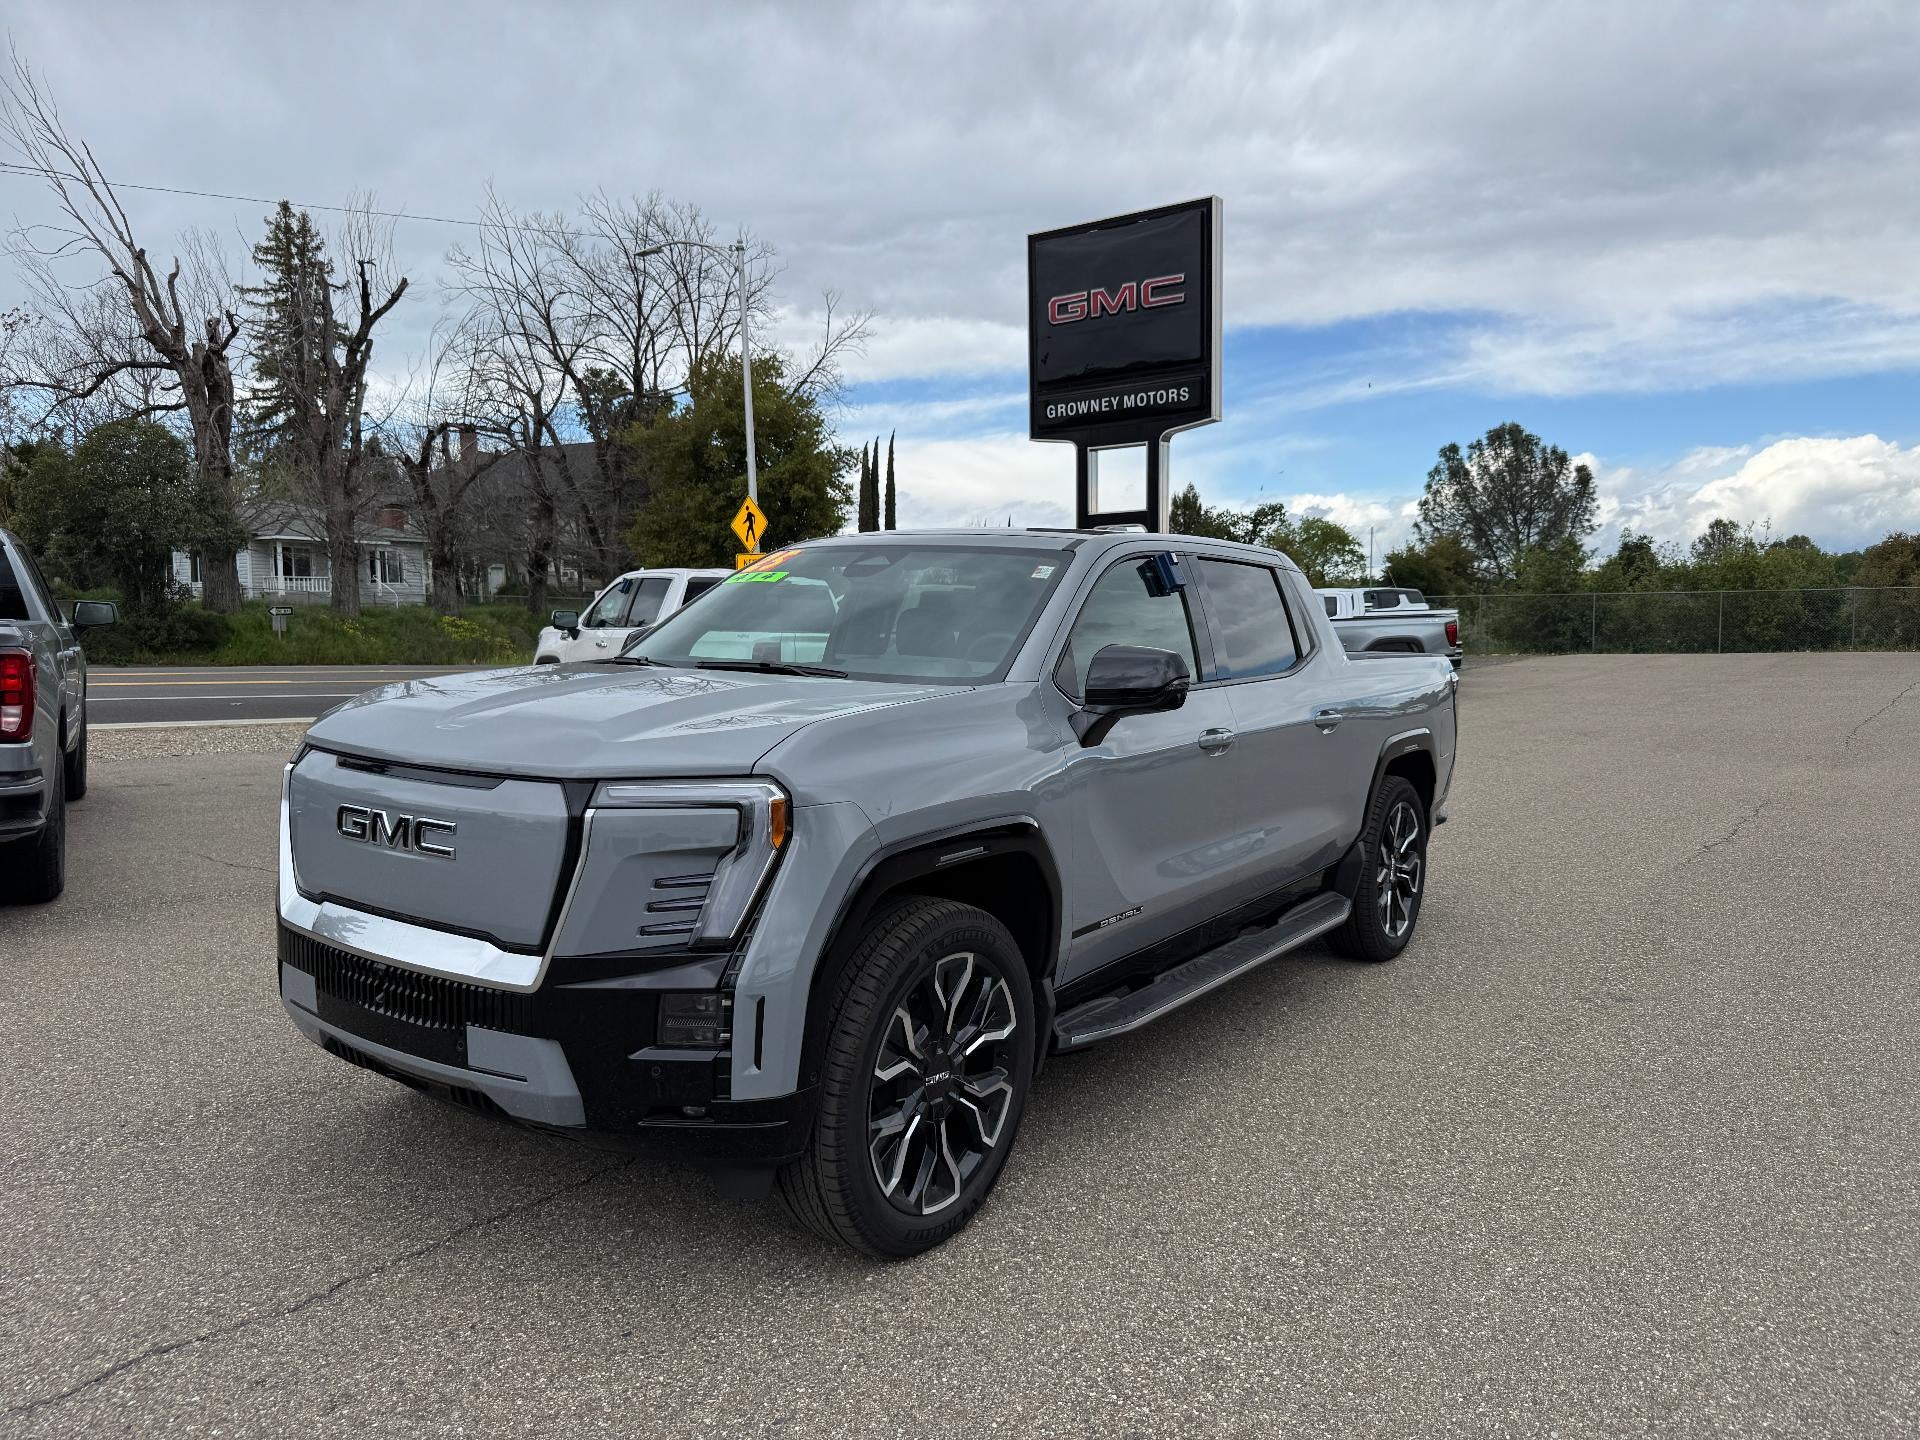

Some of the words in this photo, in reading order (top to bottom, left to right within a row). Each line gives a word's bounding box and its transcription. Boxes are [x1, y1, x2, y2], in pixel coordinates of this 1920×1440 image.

[1048, 272, 1185, 325] GMC
[1046, 396, 1120, 418] GROWNEY
[1123, 387, 1189, 408] MOTORS
[337, 803, 457, 860] GMC
